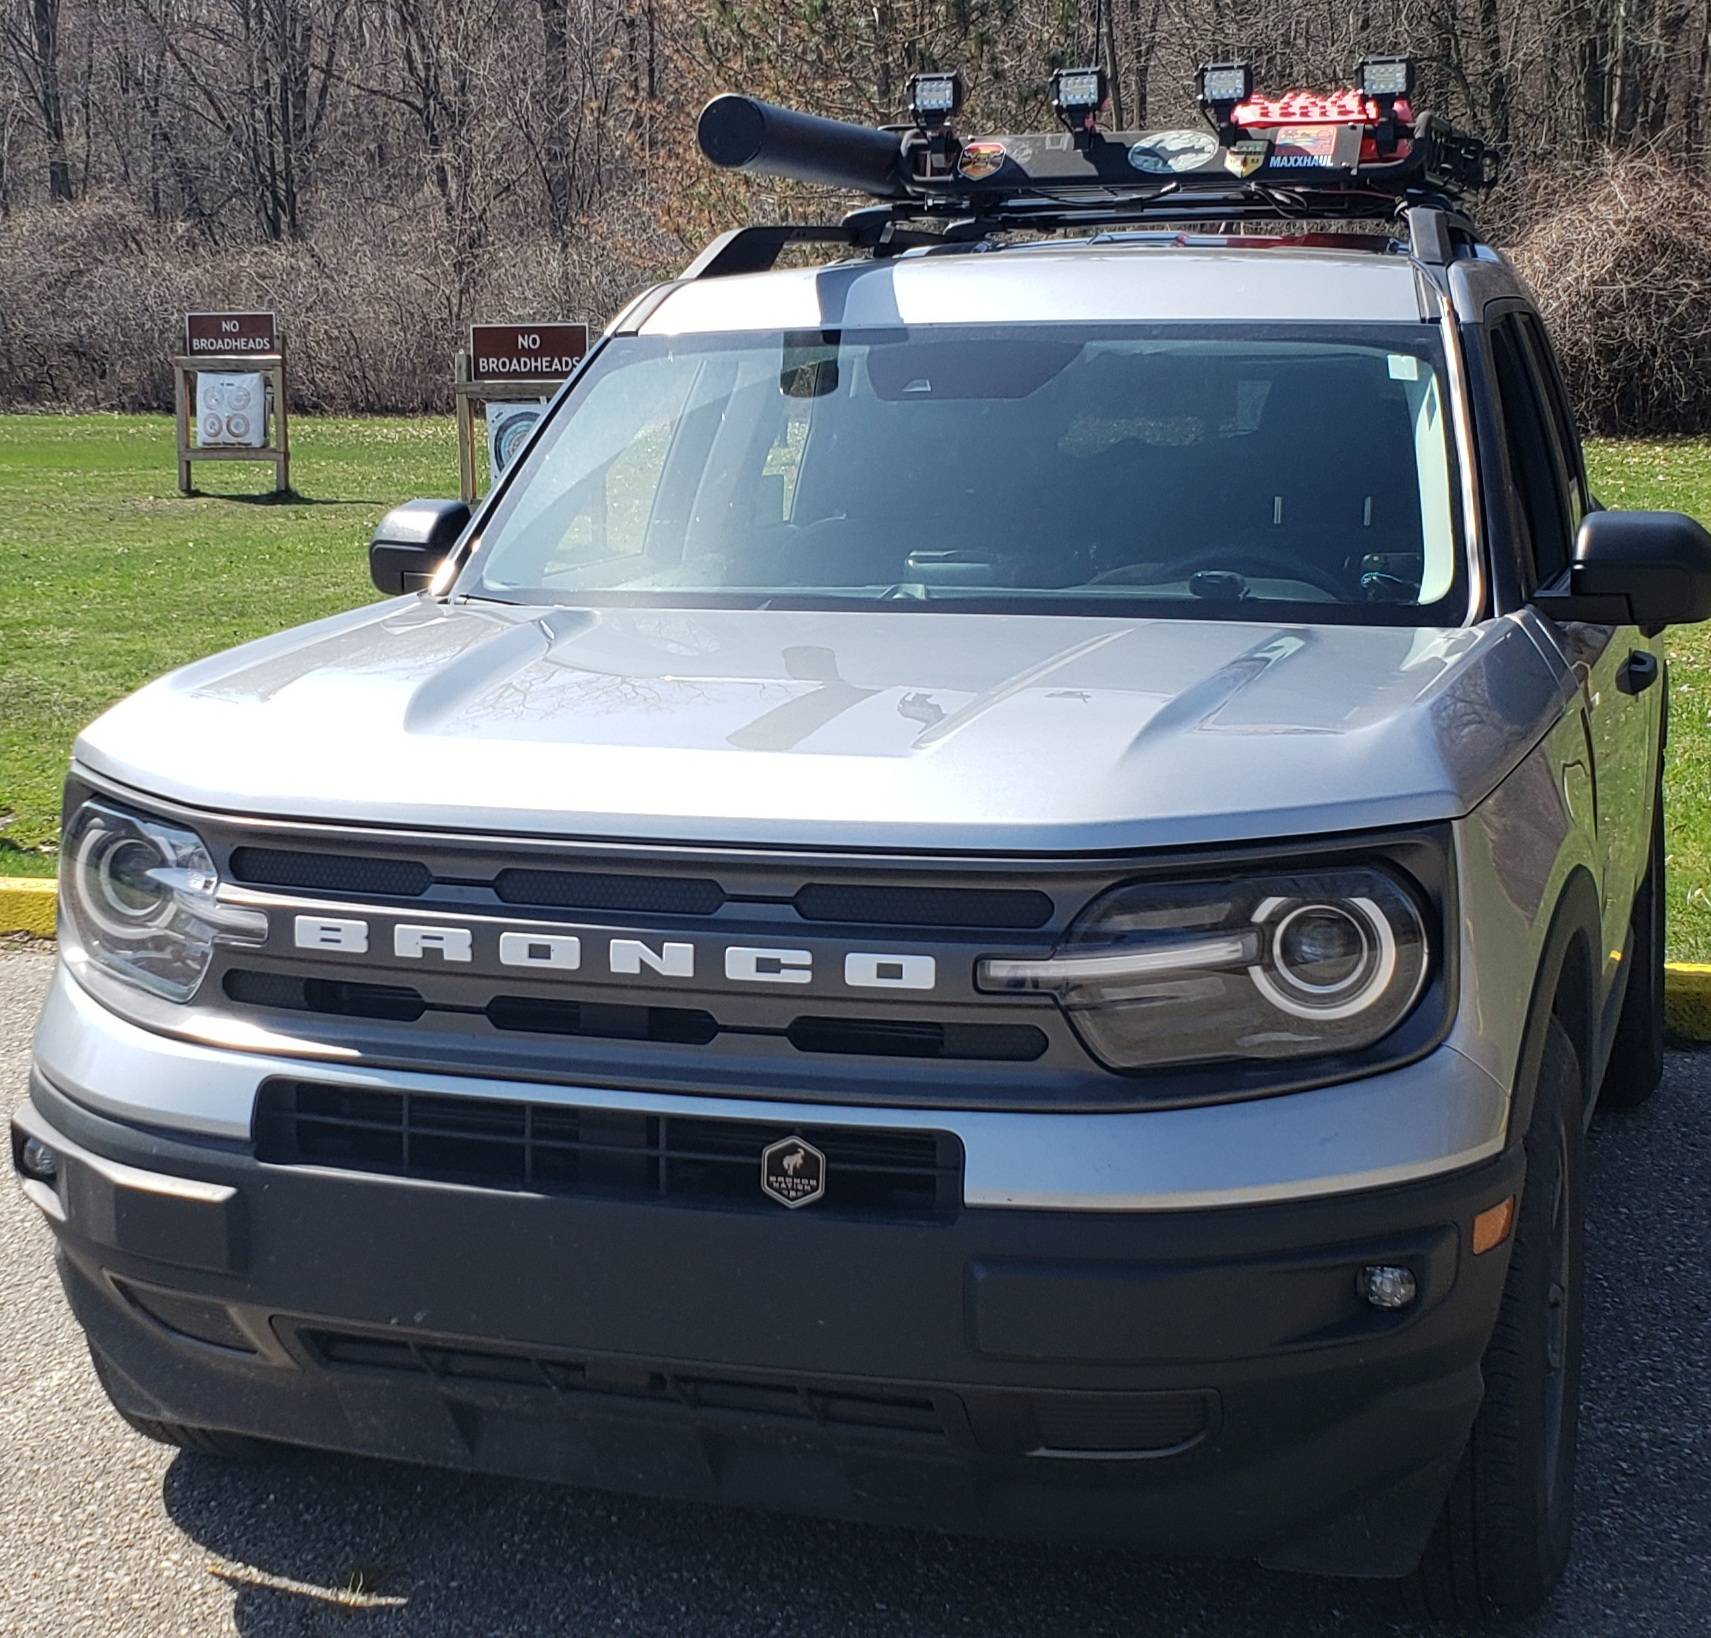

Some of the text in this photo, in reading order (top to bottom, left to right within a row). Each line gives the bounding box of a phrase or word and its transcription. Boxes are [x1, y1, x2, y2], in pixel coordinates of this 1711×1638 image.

[1269, 155, 1333, 167] MAXXHAUL
[221, 320, 240, 333] NO
[192, 338, 271, 351] BROADHEADS
[517, 334, 541, 350] NO
[479, 357, 581, 373] BROADHEADS
[294, 915, 936, 990] BRONCO
